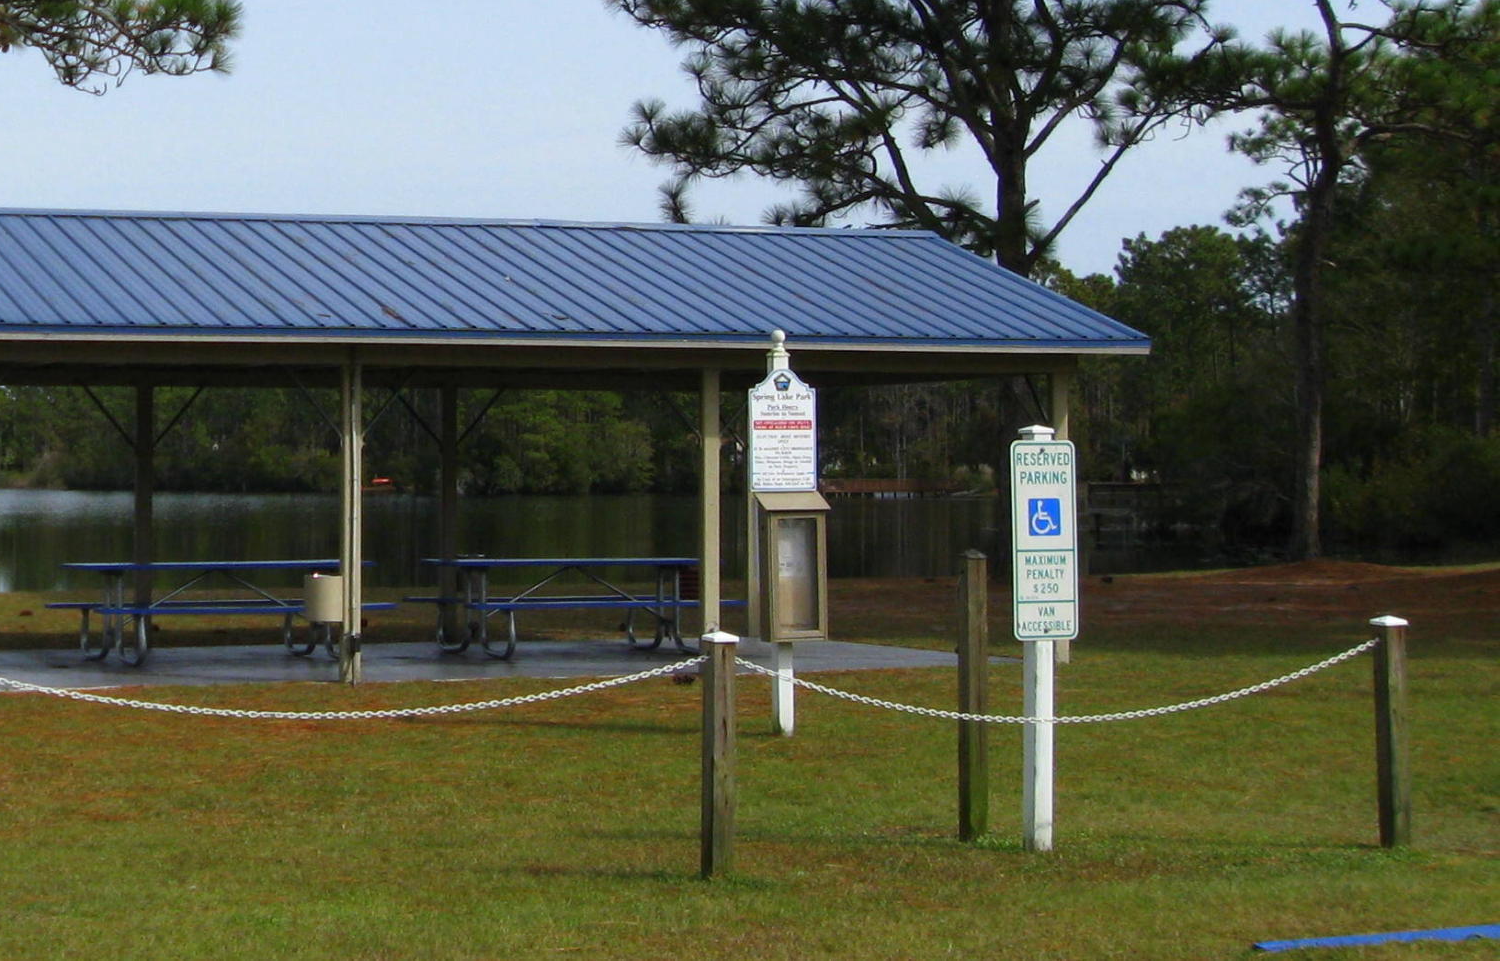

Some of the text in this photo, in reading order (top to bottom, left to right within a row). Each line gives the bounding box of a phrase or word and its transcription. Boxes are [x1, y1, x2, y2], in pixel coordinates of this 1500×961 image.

[753, 393, 775, 402] Spring
[1016, 452, 1070, 466] RESERVED
[1020, 471, 1067, 485] PARKING
[1025, 555, 1066, 565] MAXIMUM
[1027, 569, 1064, 579] PENALTY
[1033, 583, 1059, 594] $250
[1038, 606, 1055, 616] VAN
[1021, 620, 1071, 631] ACCESSIBLE
